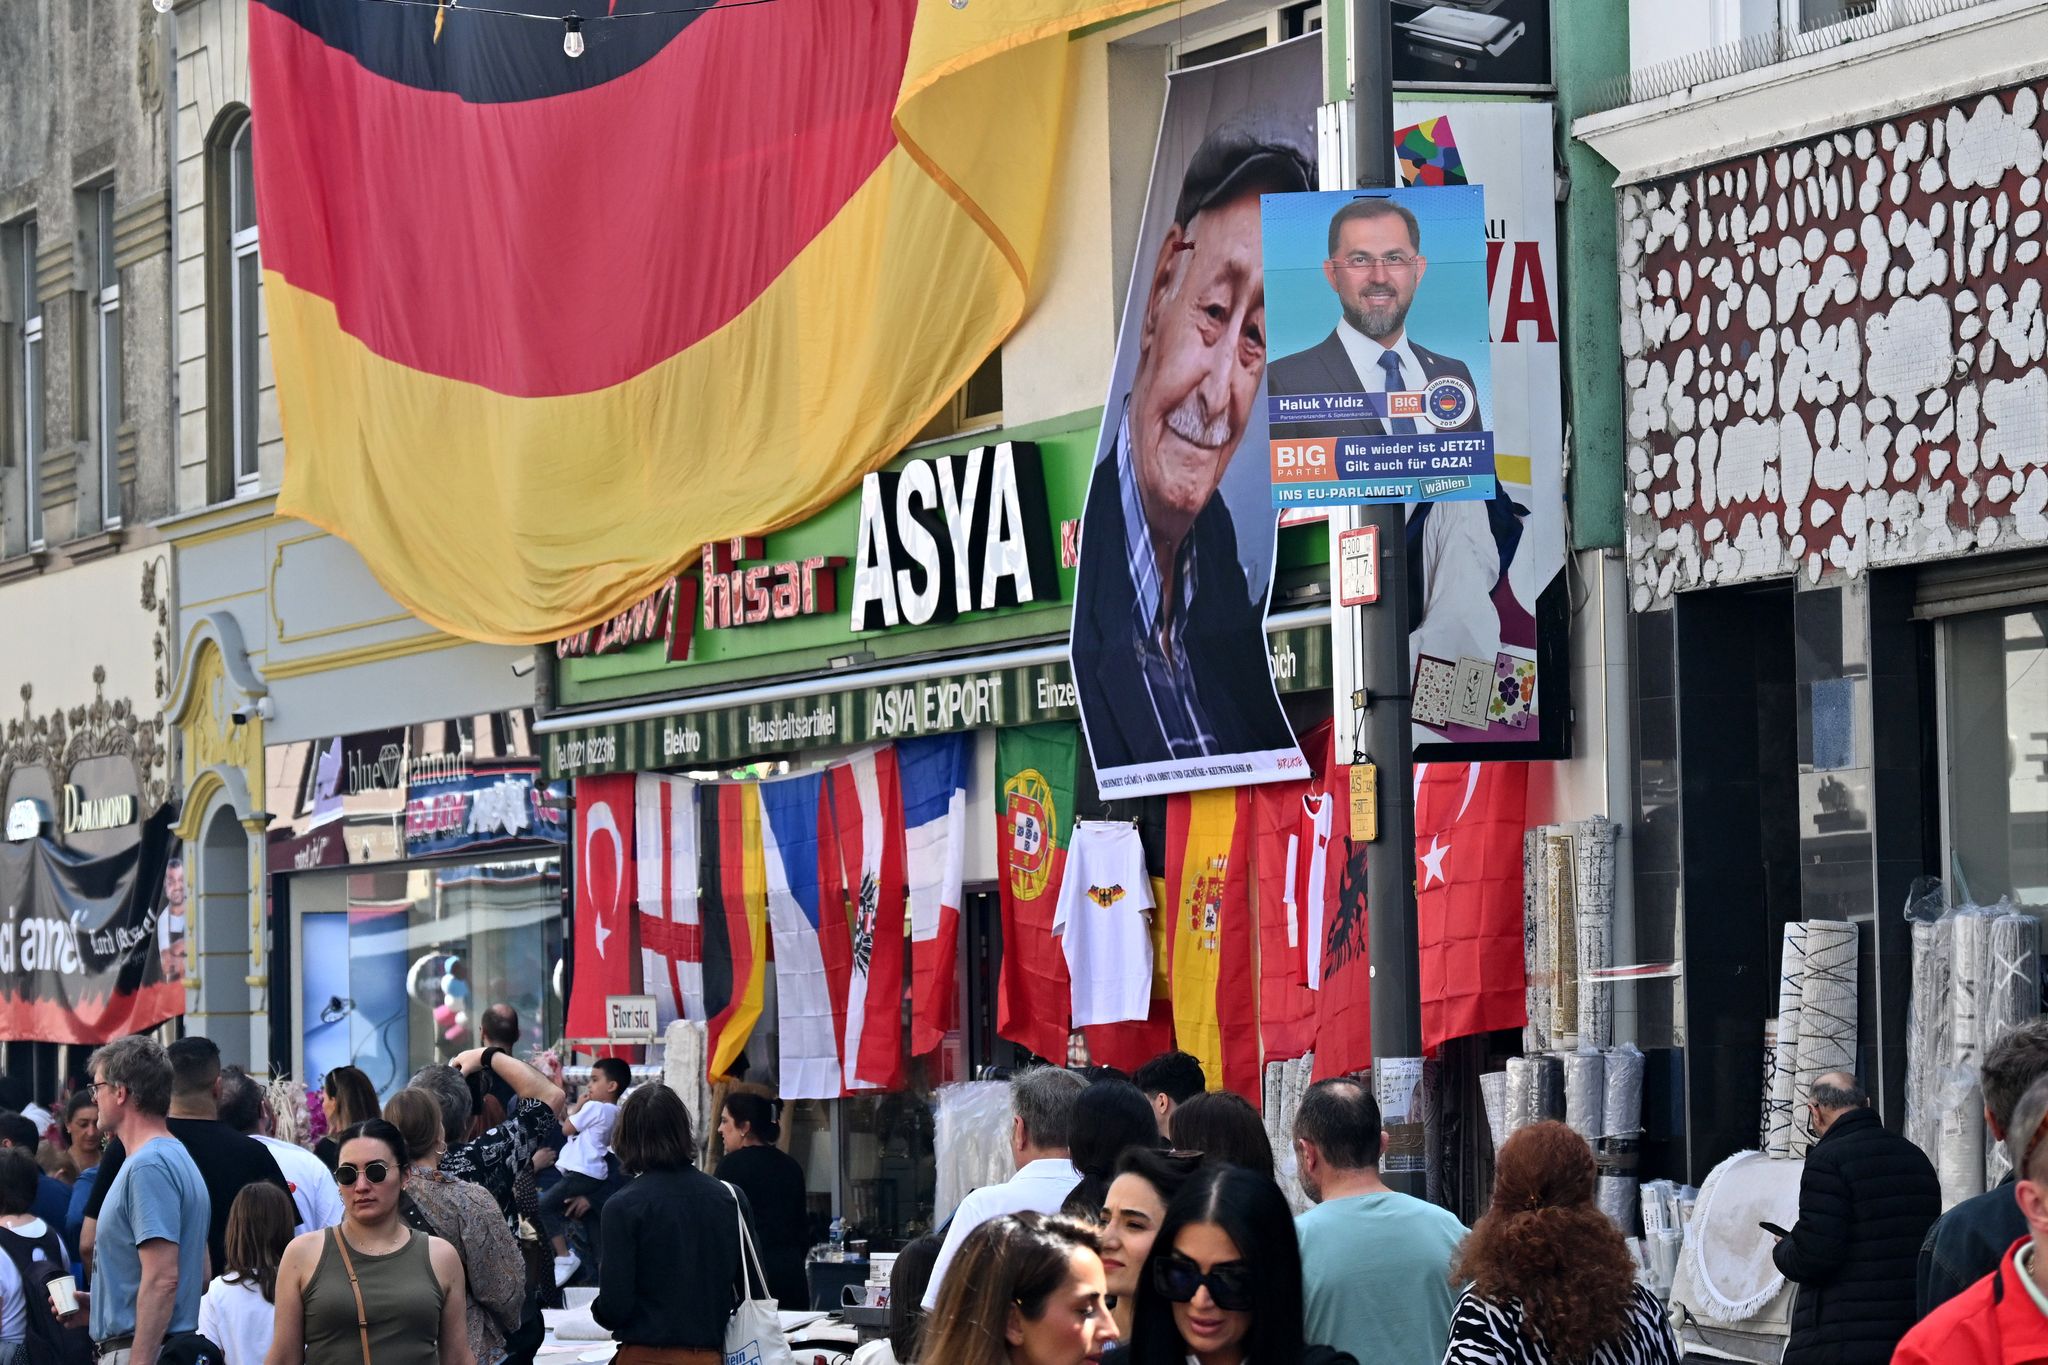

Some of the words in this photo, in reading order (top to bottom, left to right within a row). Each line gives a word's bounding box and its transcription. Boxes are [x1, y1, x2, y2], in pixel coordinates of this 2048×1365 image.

[1428, 379, 1466, 392] EUROPAWAHL
[1279, 397, 1320, 411] Haluk
[1324, 396, 1364, 409] Yıldız
[1395, 397, 1418, 407] BIG
[1277, 445, 1326, 468] BIG
[1345, 444, 1367, 456] Nie
[1371, 443, 1414, 455] wieder
[1418, 442, 1436, 453] ist
[1440, 439, 1485, 452] JETZT!
[1277, 467, 1327, 477] PARTEI
[1345, 460, 1370, 472] Gilt
[1374, 459, 1403, 471] auch
[1407, 458, 1427, 469] für
[1431, 456, 1472, 469] GAZA!
[1279, 489, 1303, 500] INS
[1307, 485, 1413, 499] EU-PARLAMENT
[1425, 478, 1465, 494] wählen
[850, 440, 1035, 633] ASYA
[702, 536, 825, 630] hisar
[872, 689, 918, 736] ASYA
[923, 677, 1002, 729] EXPORT
[748, 706, 836, 744] Haushaltsartikel
[587, 736, 616, 764] 622316
[664, 726, 701, 756] Elektro
[348, 749, 380, 796] blue
[399, 744, 467, 788] diamond
[1171, 769, 1184, 780] UND
[1207, 764, 1247, 776] KEUPSTRASSE
[612, 1004, 649, 1028] Florista
